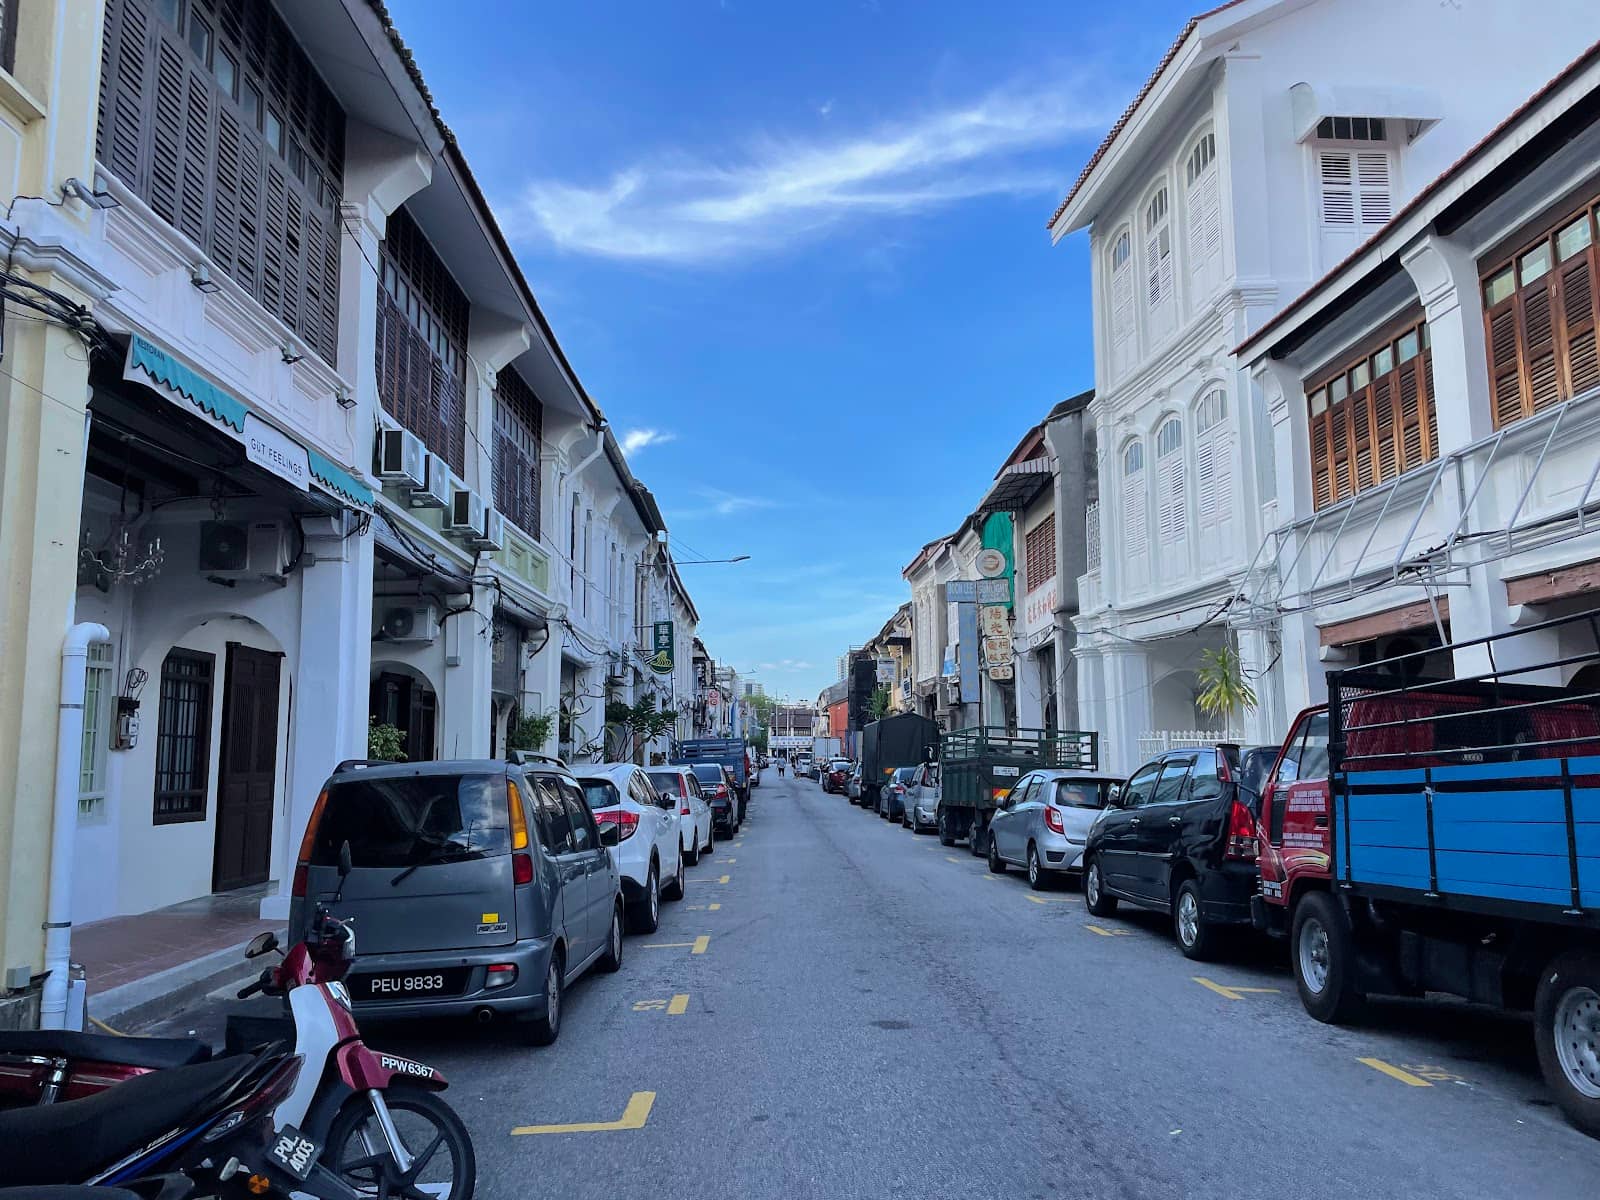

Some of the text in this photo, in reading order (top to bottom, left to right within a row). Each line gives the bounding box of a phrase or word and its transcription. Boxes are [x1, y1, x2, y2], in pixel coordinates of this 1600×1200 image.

[268, 448, 303, 477] FEELINGS
[371, 975, 443, 993] PEU 9833
[289, 1139, 315, 1172] 4003
